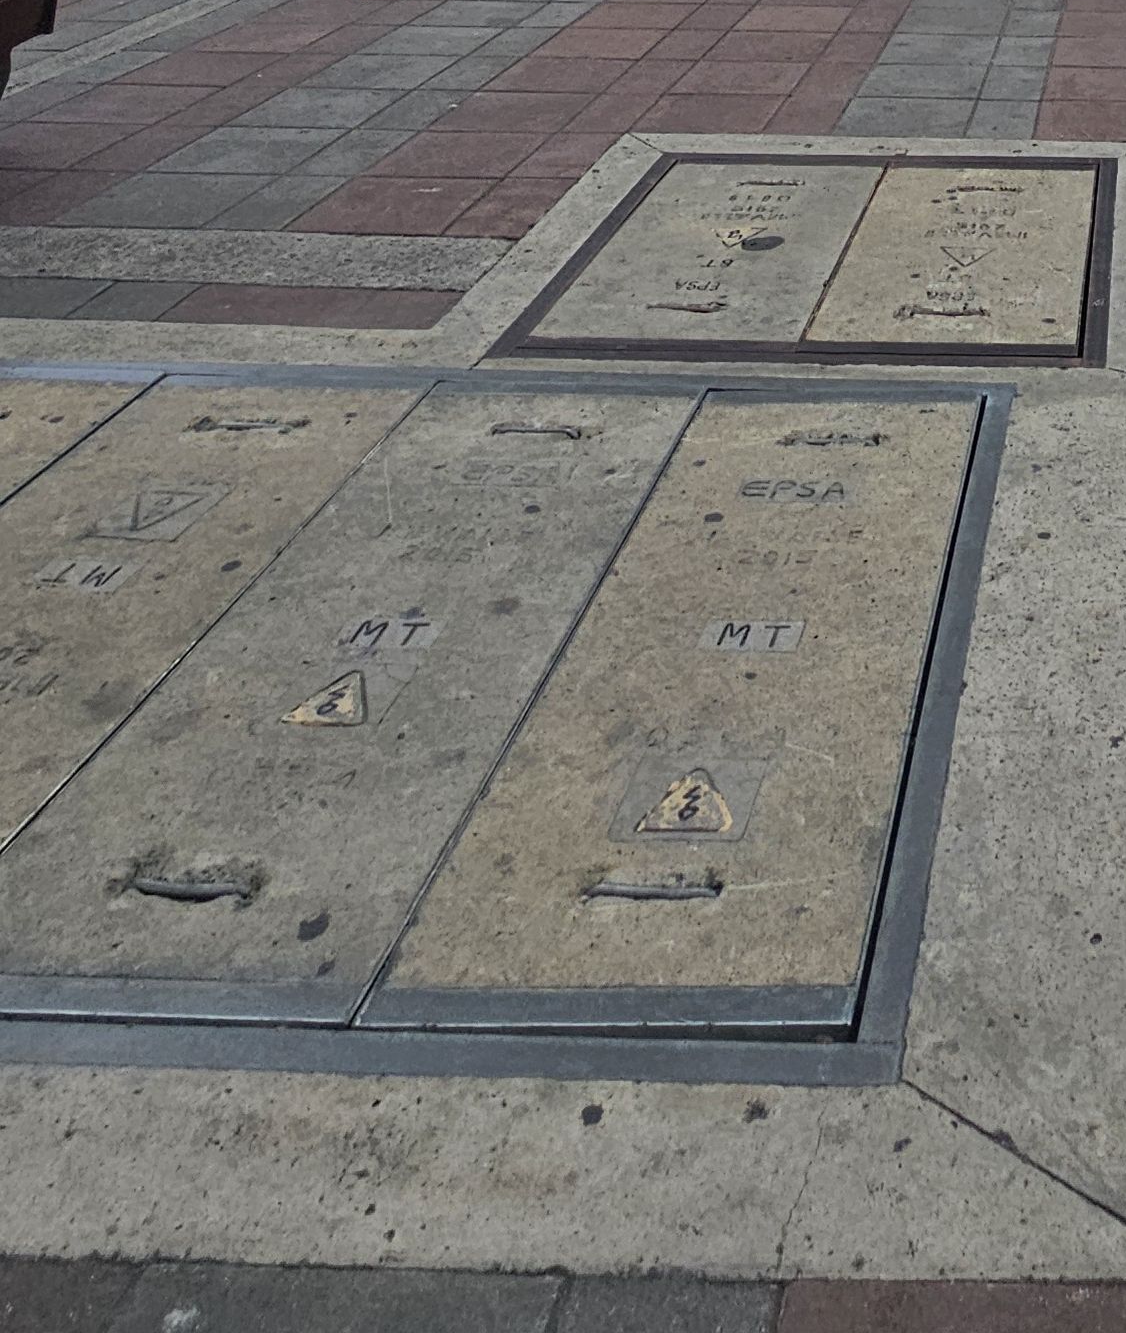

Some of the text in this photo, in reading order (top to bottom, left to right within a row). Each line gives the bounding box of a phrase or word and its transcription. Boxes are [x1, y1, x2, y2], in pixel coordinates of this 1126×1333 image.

[742, 480, 845, 499] EPSA
[349, 620, 431, 647] MT
[717, 622, 792, 648] MT
